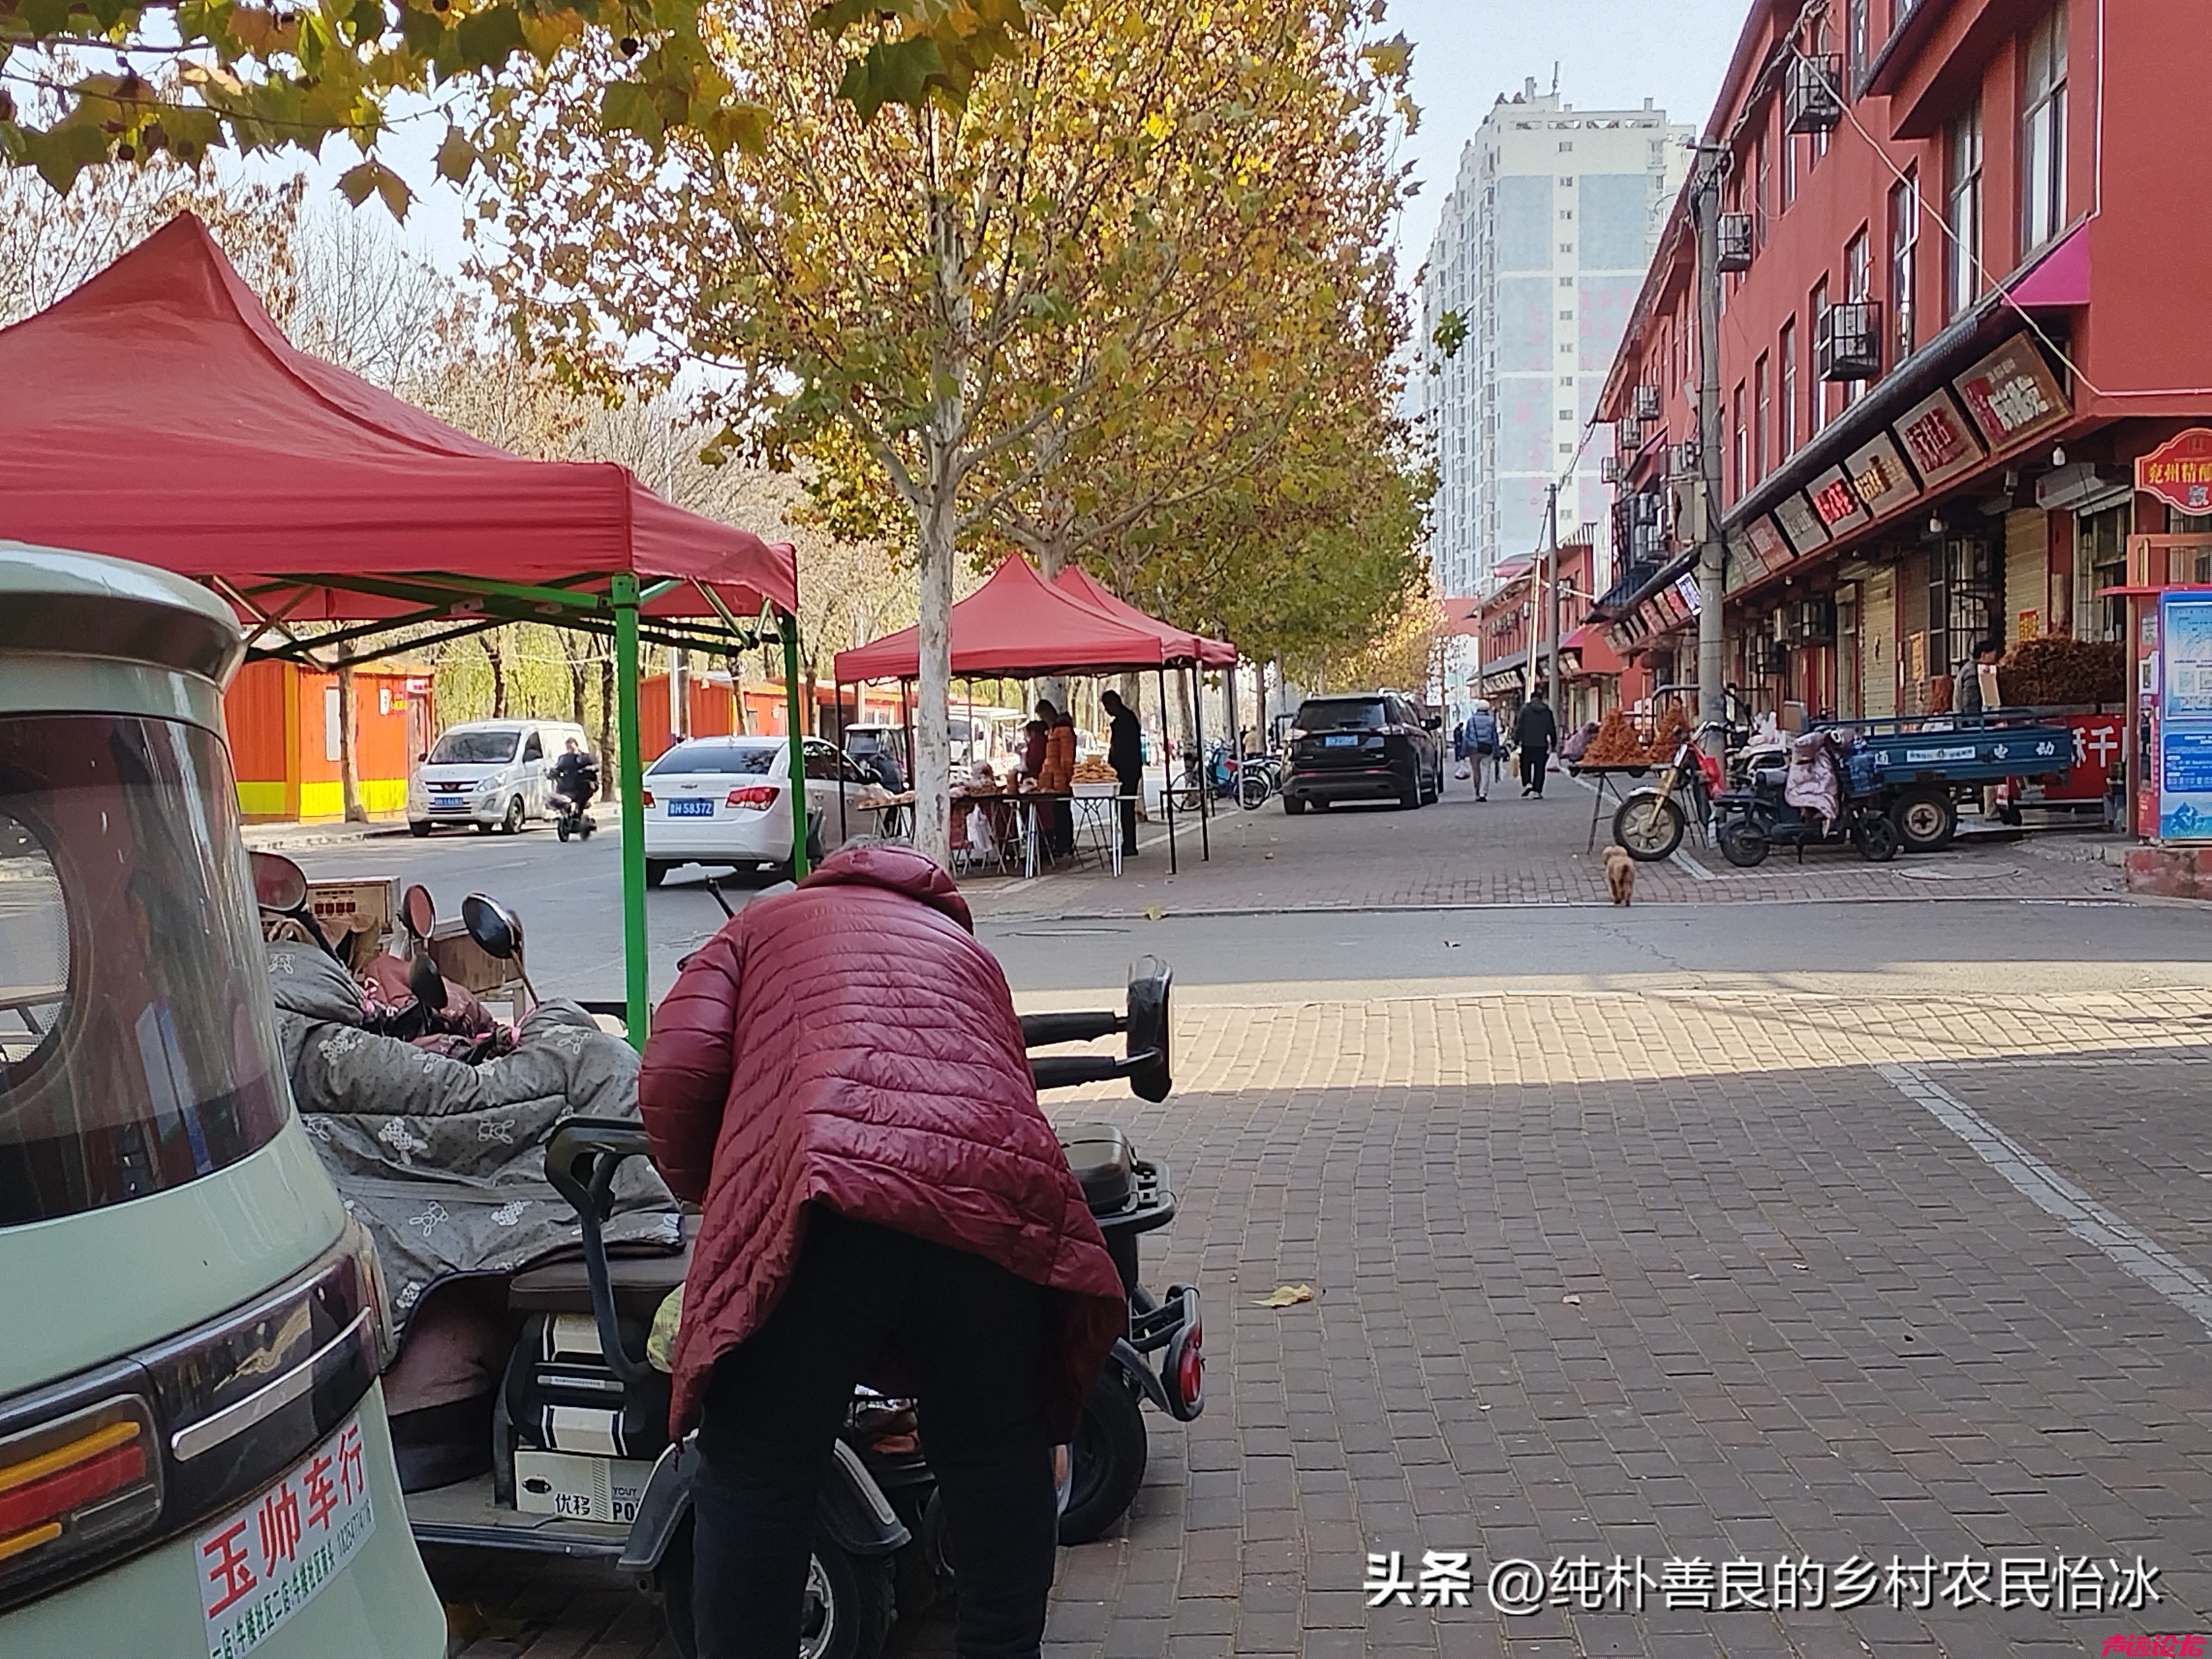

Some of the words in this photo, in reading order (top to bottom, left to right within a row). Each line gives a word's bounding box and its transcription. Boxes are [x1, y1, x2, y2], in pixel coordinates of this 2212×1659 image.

[555, 1493, 590, 1515] 优移
[612, 1502, 638, 1521] PO
[203, 1425, 364, 1619] 玉帅车行
